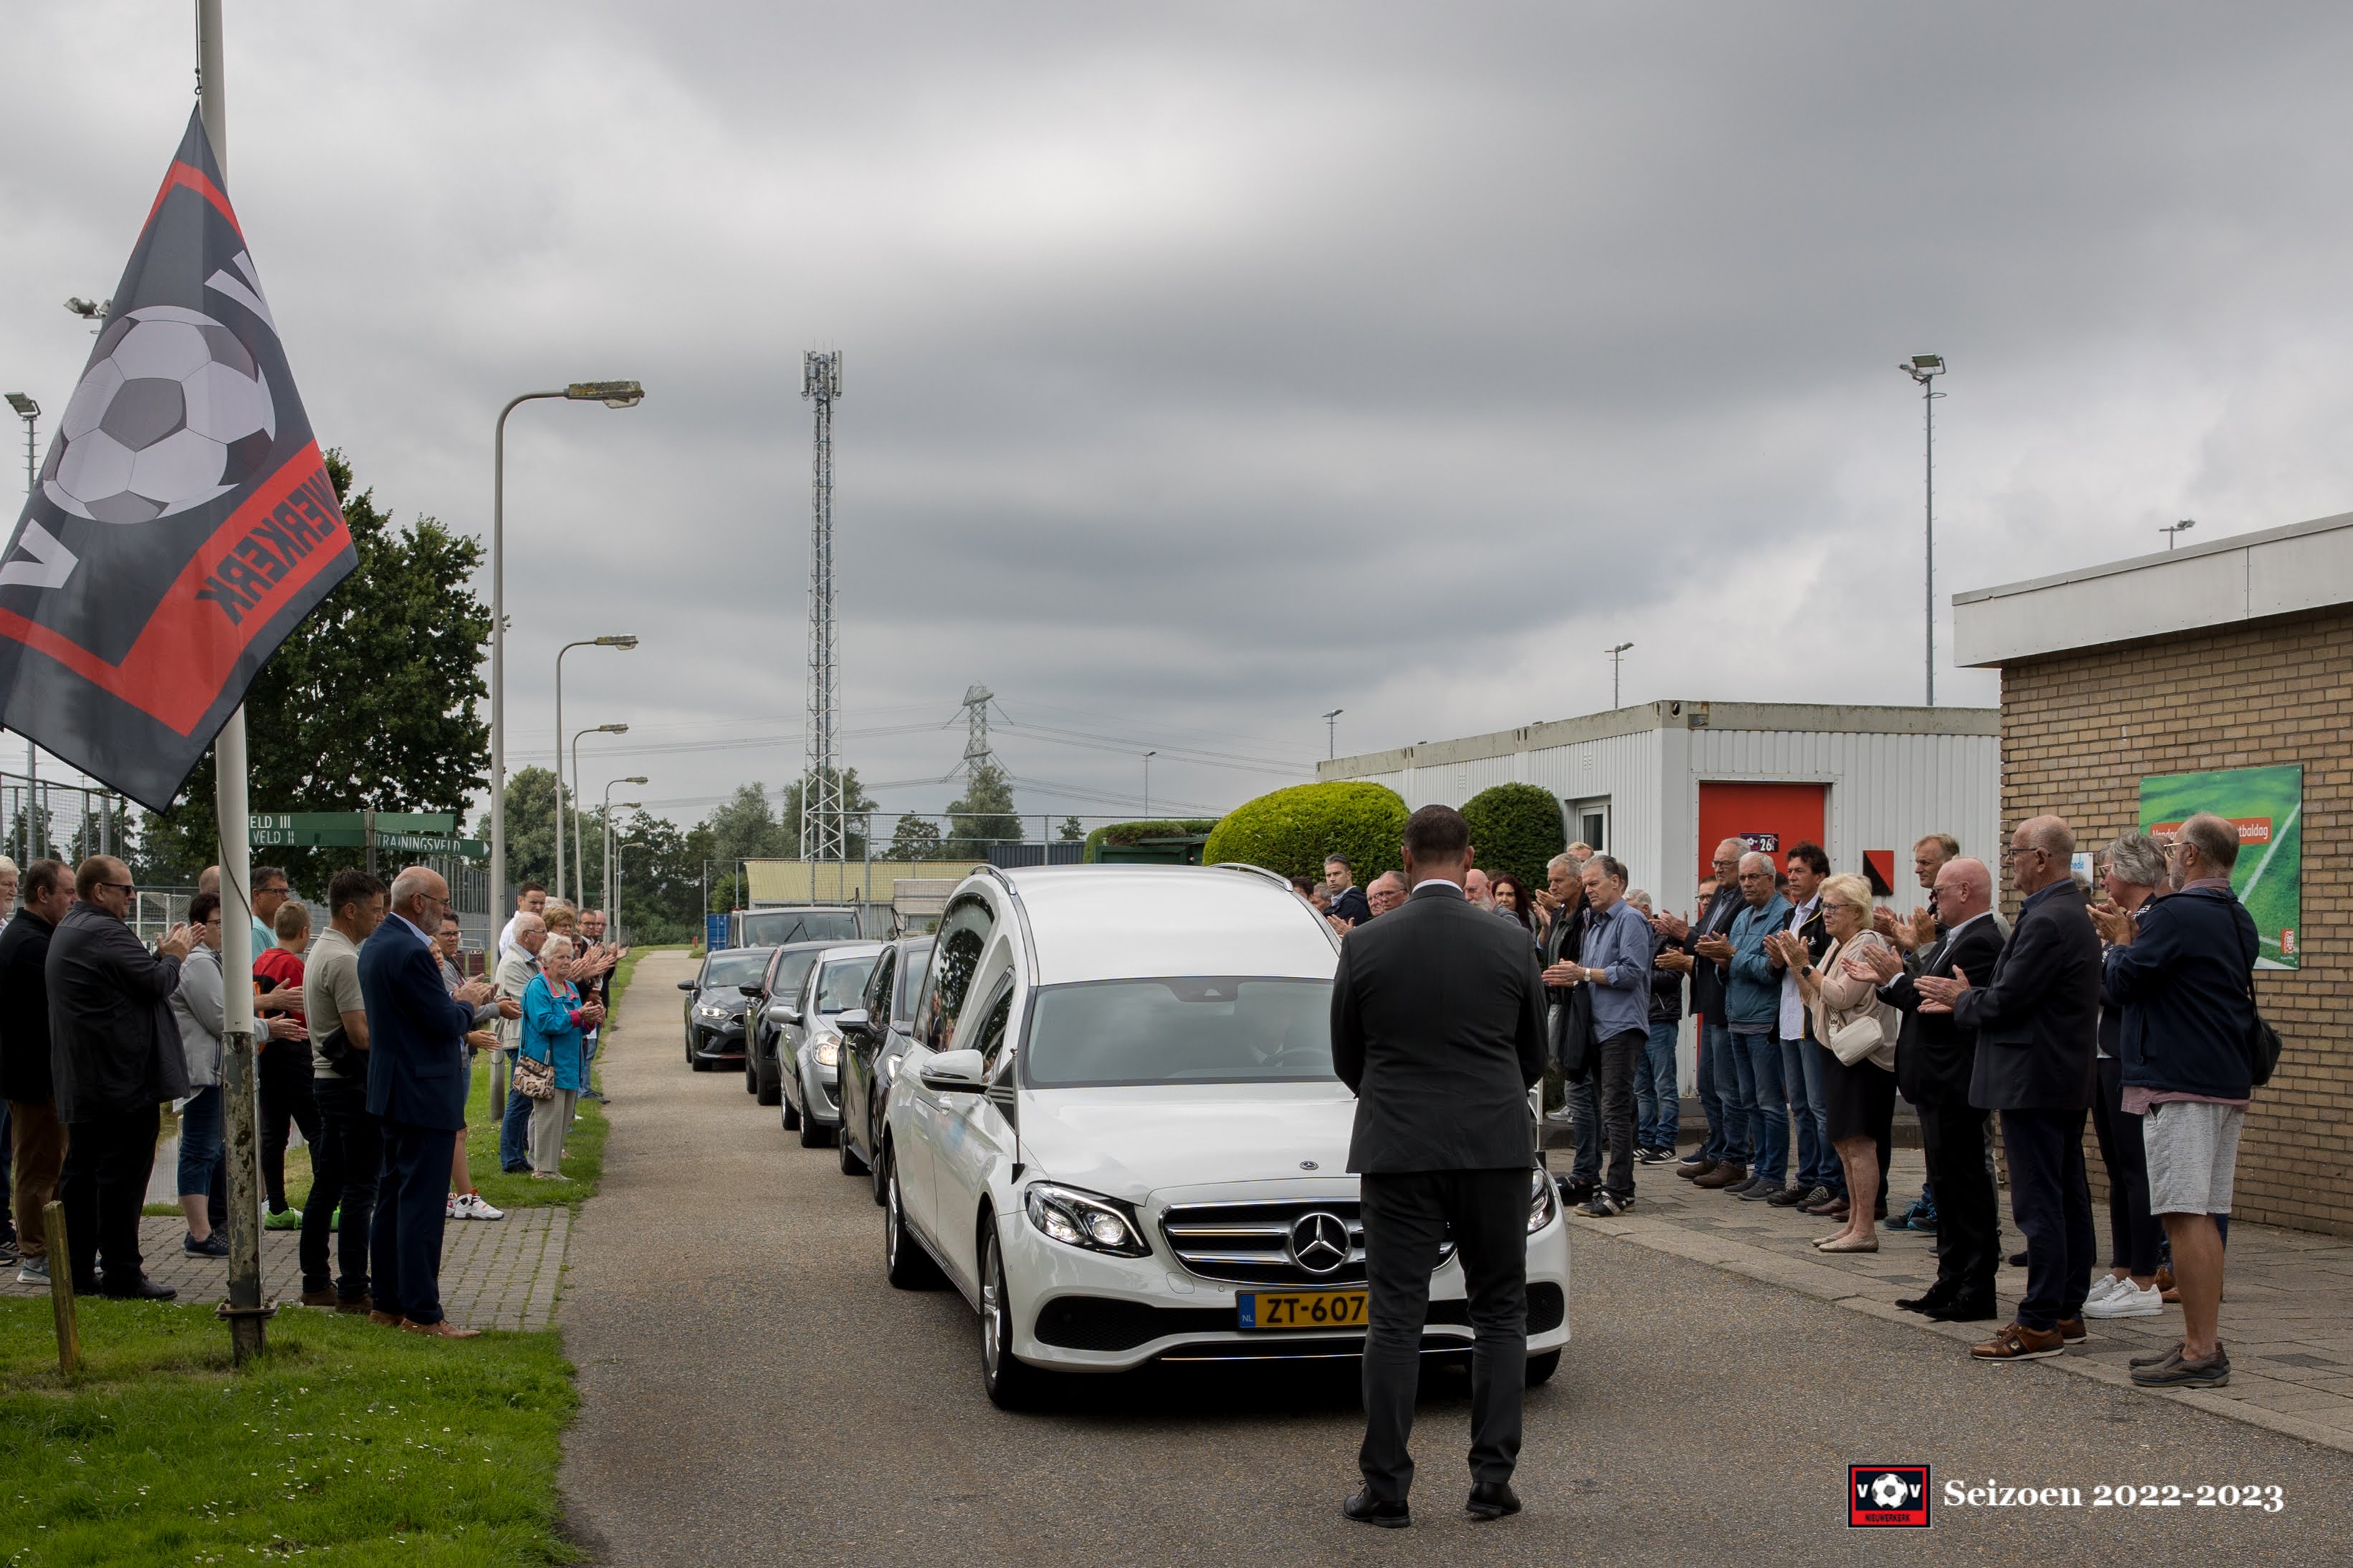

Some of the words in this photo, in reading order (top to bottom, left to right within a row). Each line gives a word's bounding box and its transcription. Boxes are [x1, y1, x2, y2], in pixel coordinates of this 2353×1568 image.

[249, 815, 272, 829] ELD
[253, 831, 281, 844] VELD
[2239, 824, 2268, 840] tbaldag
[377, 834, 461, 853] TRAININGSVELD
[1760, 838, 1772, 851] 26
[1267, 1297, 1365, 1323] ZT-607
